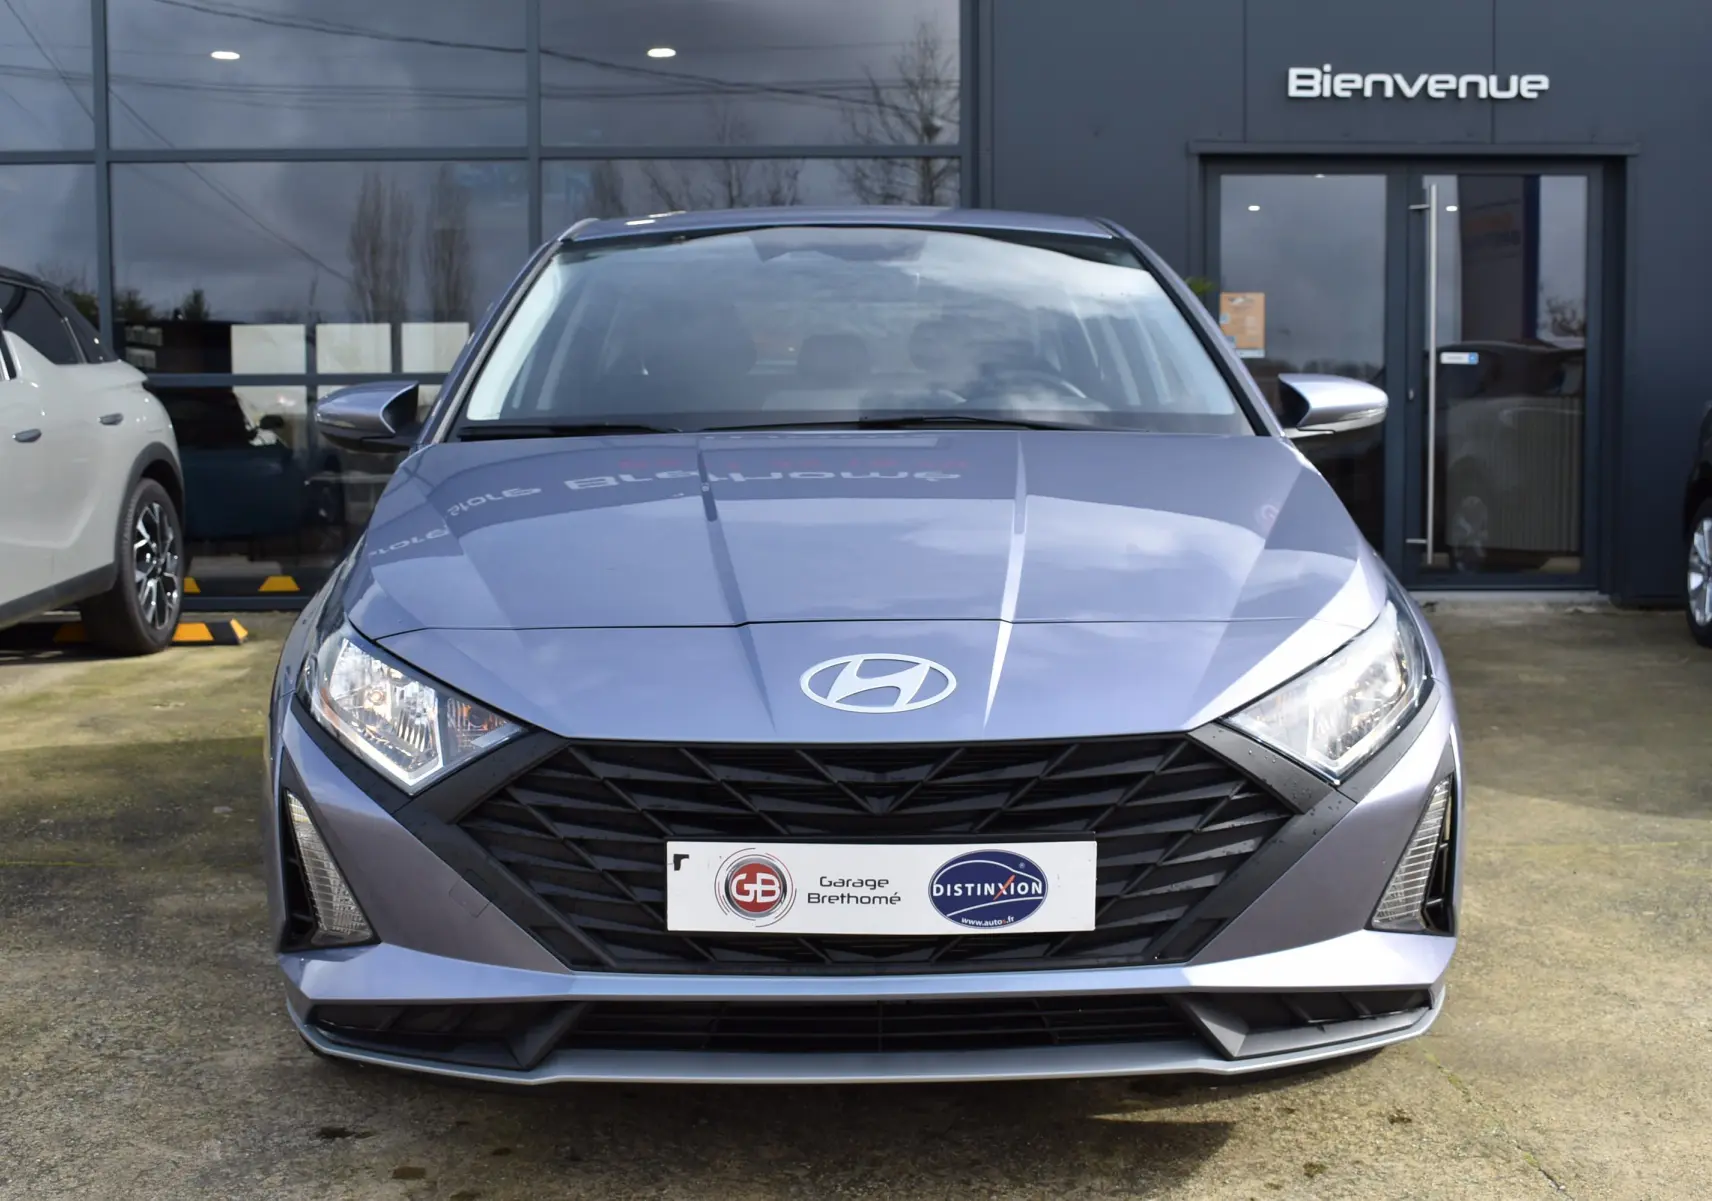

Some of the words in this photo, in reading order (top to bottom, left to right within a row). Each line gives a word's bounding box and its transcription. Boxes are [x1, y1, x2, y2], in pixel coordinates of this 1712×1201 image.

[1288, 63, 1550, 99] Bienvenue
[731, 872, 782, 903] GB
[819, 876, 889, 890] Garage
[932, 874, 1043, 901] DISTINXION
[807, 892, 901, 905] Brethomé
